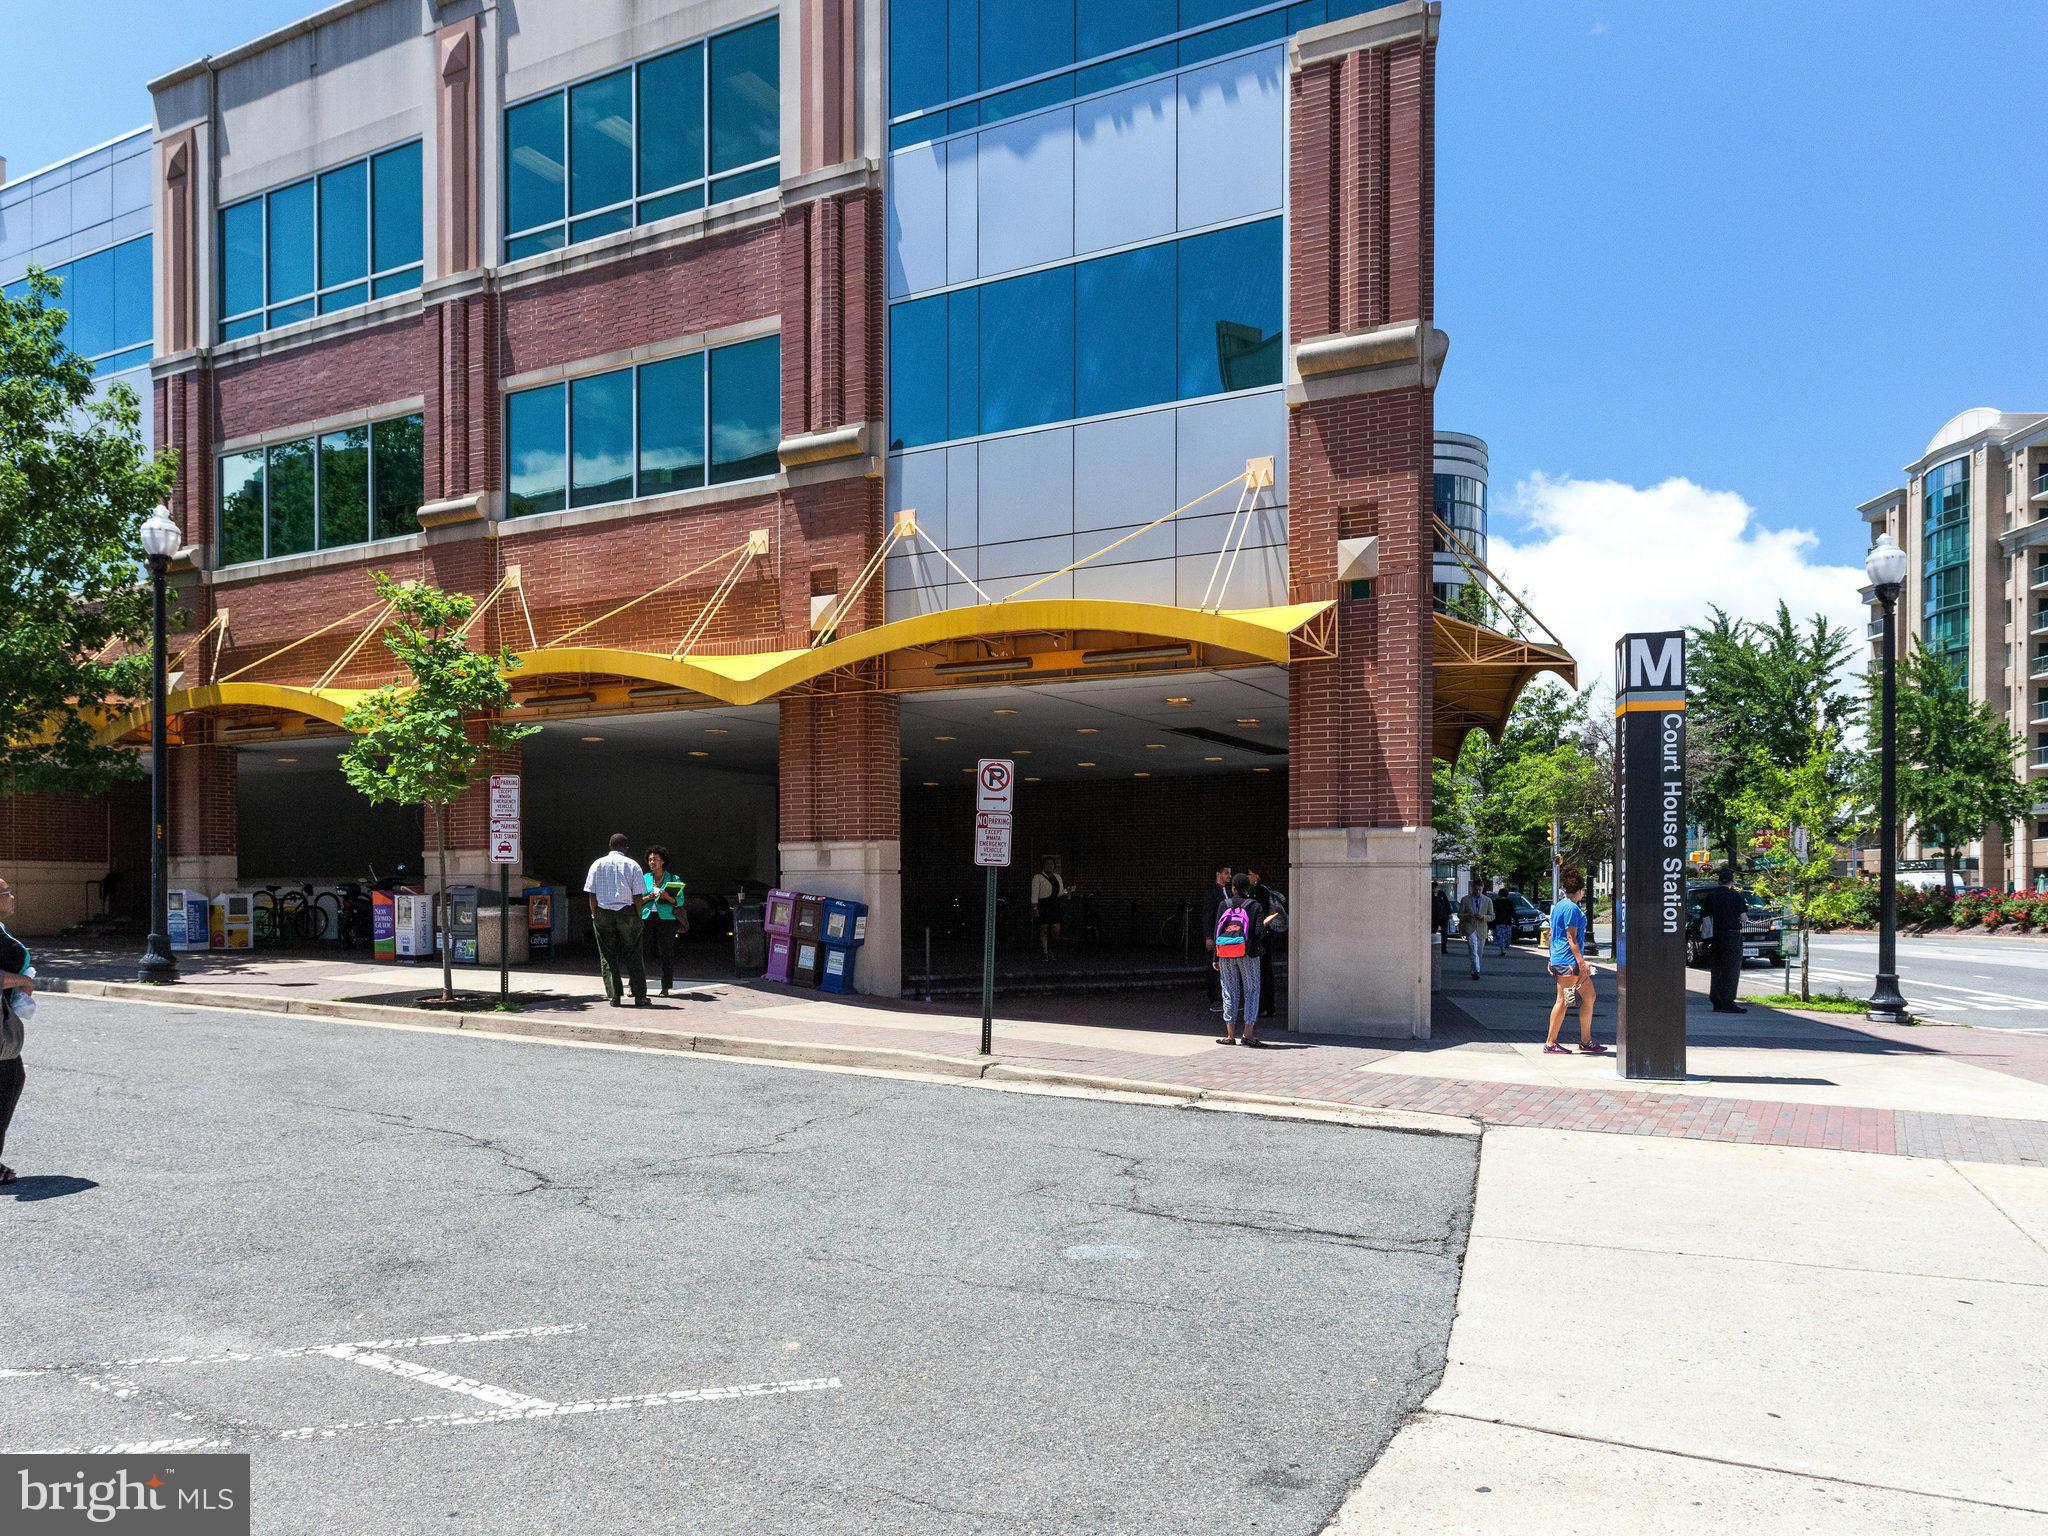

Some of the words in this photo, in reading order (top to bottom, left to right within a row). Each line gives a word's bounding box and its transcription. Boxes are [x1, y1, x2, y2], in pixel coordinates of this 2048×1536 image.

[1630, 637, 1682, 687] M
[1663, 713, 1682, 772] Court
[978, 815, 988, 826] NO
[988, 817, 1010, 826] PARKING
[1663, 781, 1682, 848] House
[1663, 857, 1682, 933] Station
